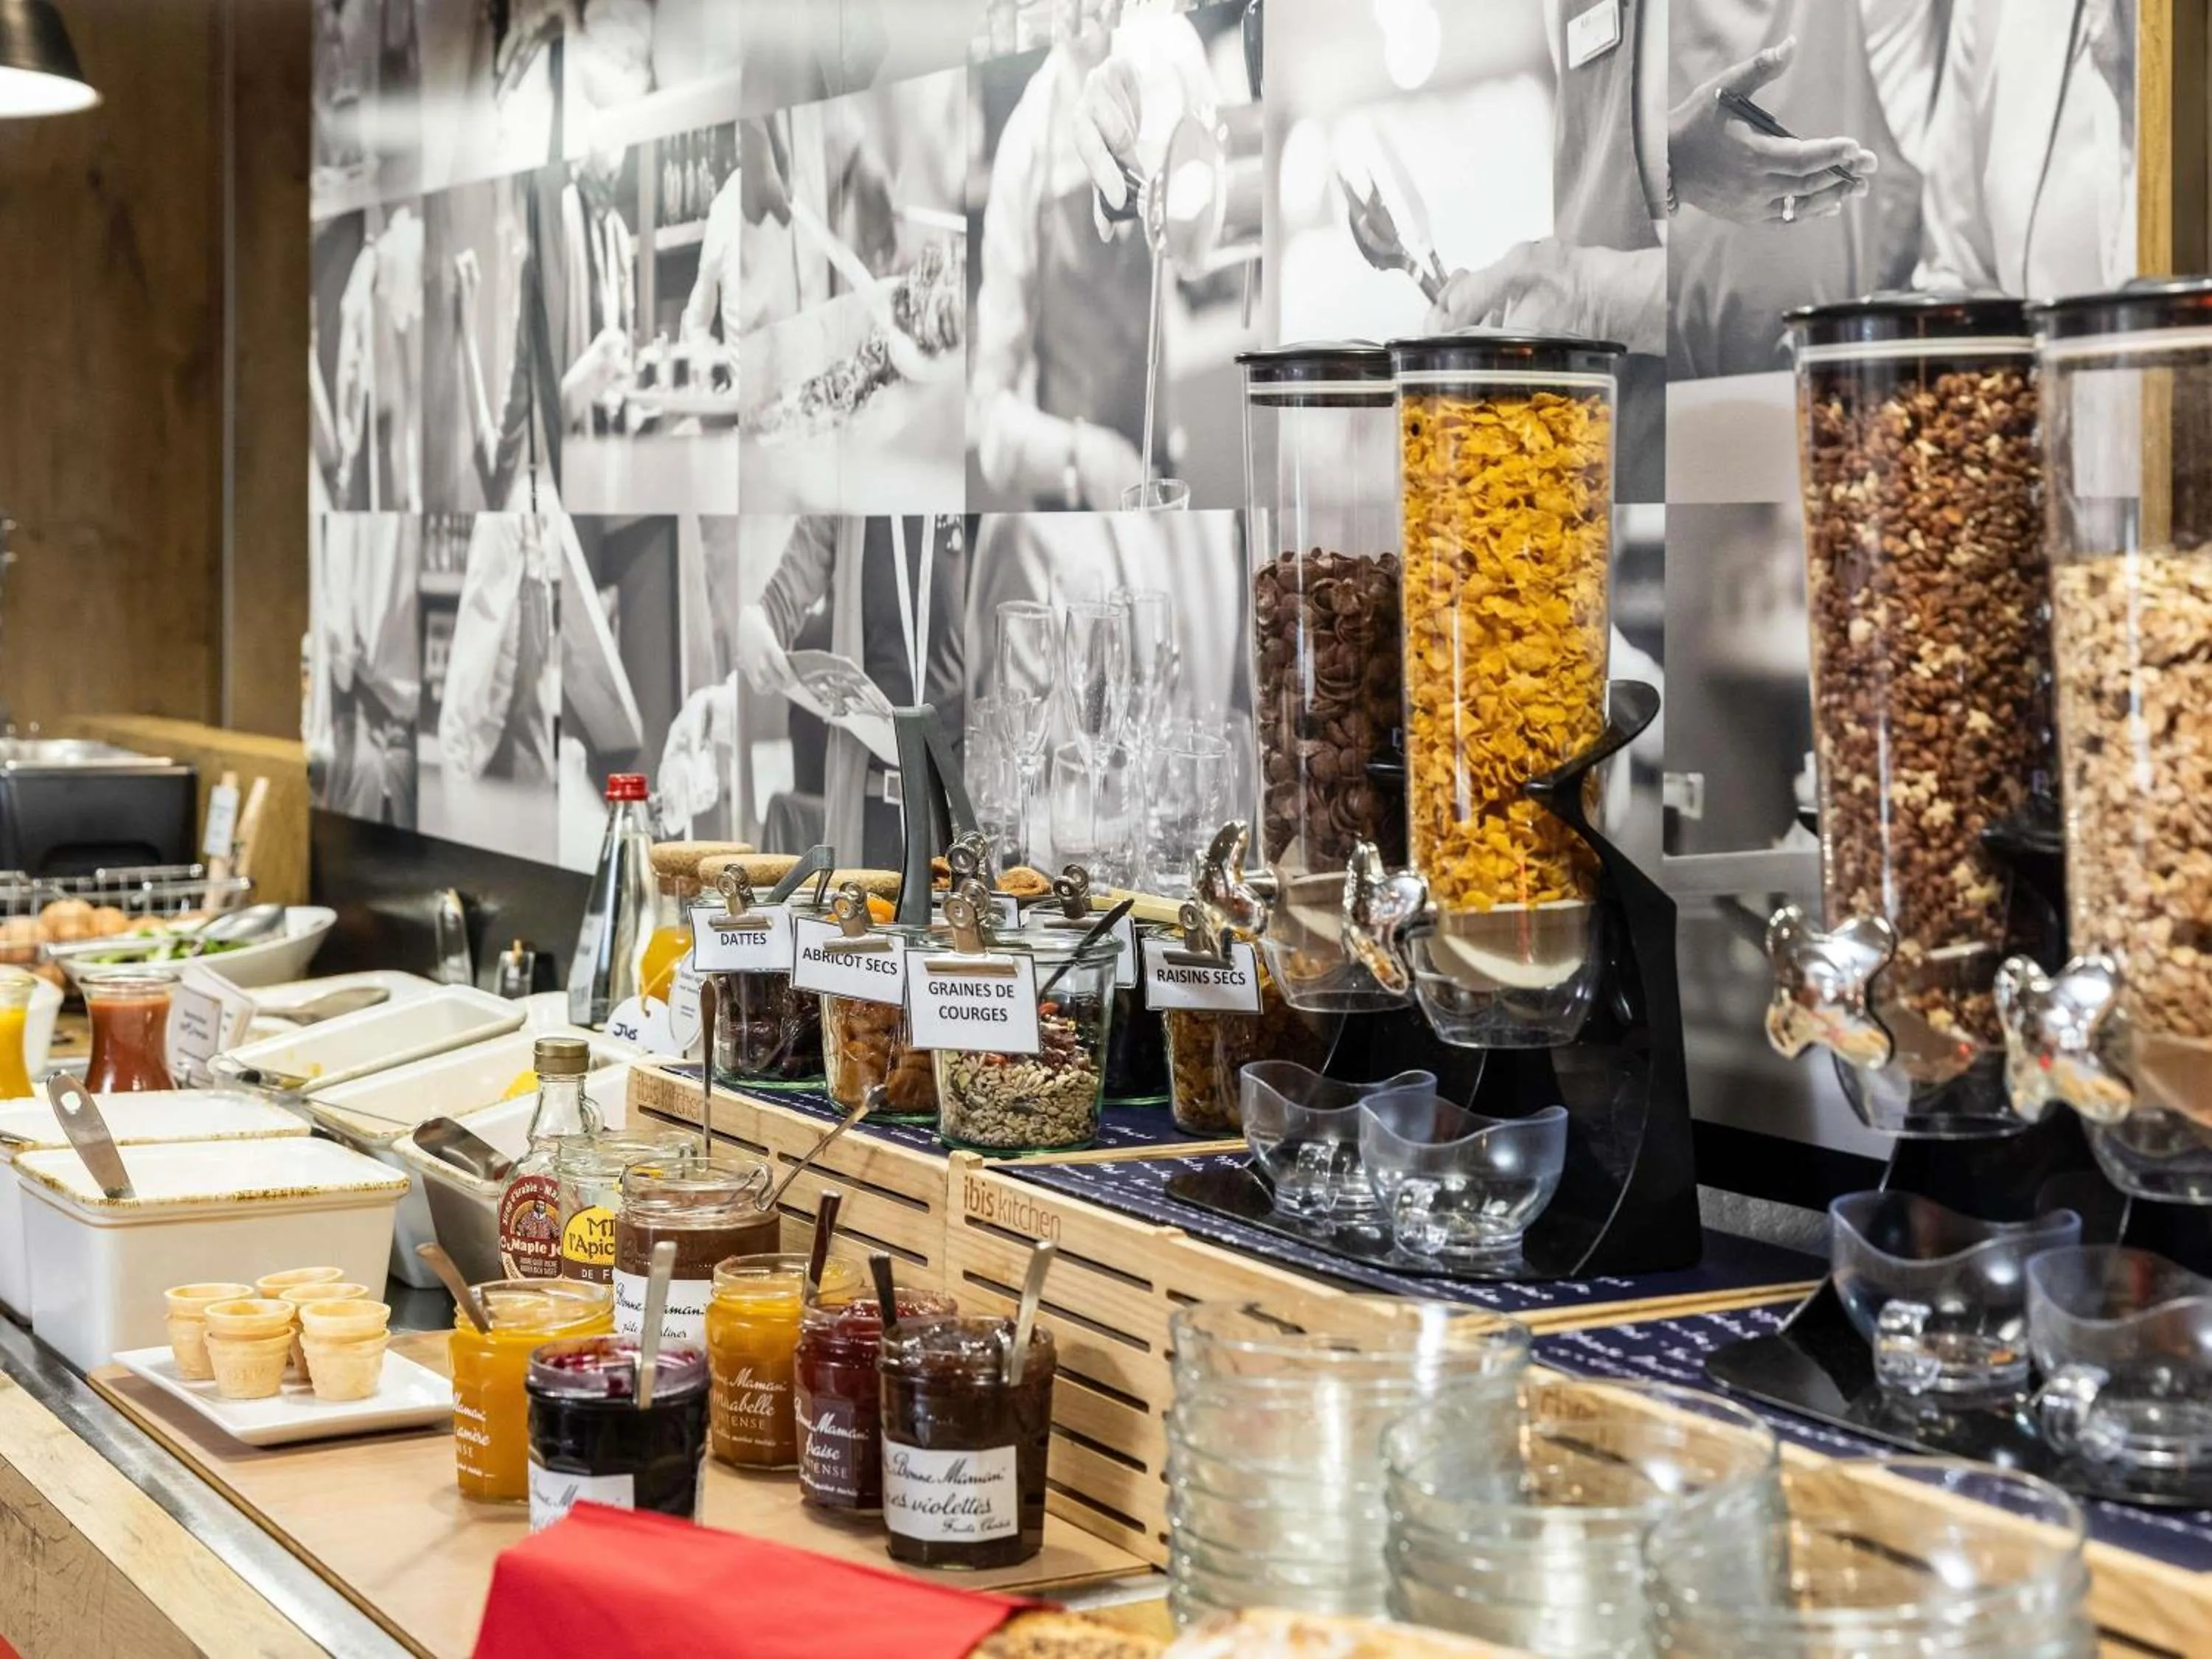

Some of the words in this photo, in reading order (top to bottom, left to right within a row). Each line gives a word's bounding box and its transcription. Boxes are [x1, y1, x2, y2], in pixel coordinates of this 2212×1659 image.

[720, 932, 766, 945] DATTES
[803, 947, 862, 968] ABRICOT
[865, 959, 897, 975] SECS
[1157, 969, 1210, 984] RAISINS
[1213, 971, 1245, 985] SECS
[928, 981, 992, 998] GRAINES
[995, 984, 1015, 998] DE
[939, 1005, 1008, 1023] COURGES
[964, 1176, 994, 1217] ibis
[998, 1187, 1061, 1242] kitchen
[587, 1217, 614, 1236] MI
[548, 1242, 563, 1256] Jo
[568, 1231, 614, 1259] l'Apic
[911, 1492, 992, 1516] violettes
